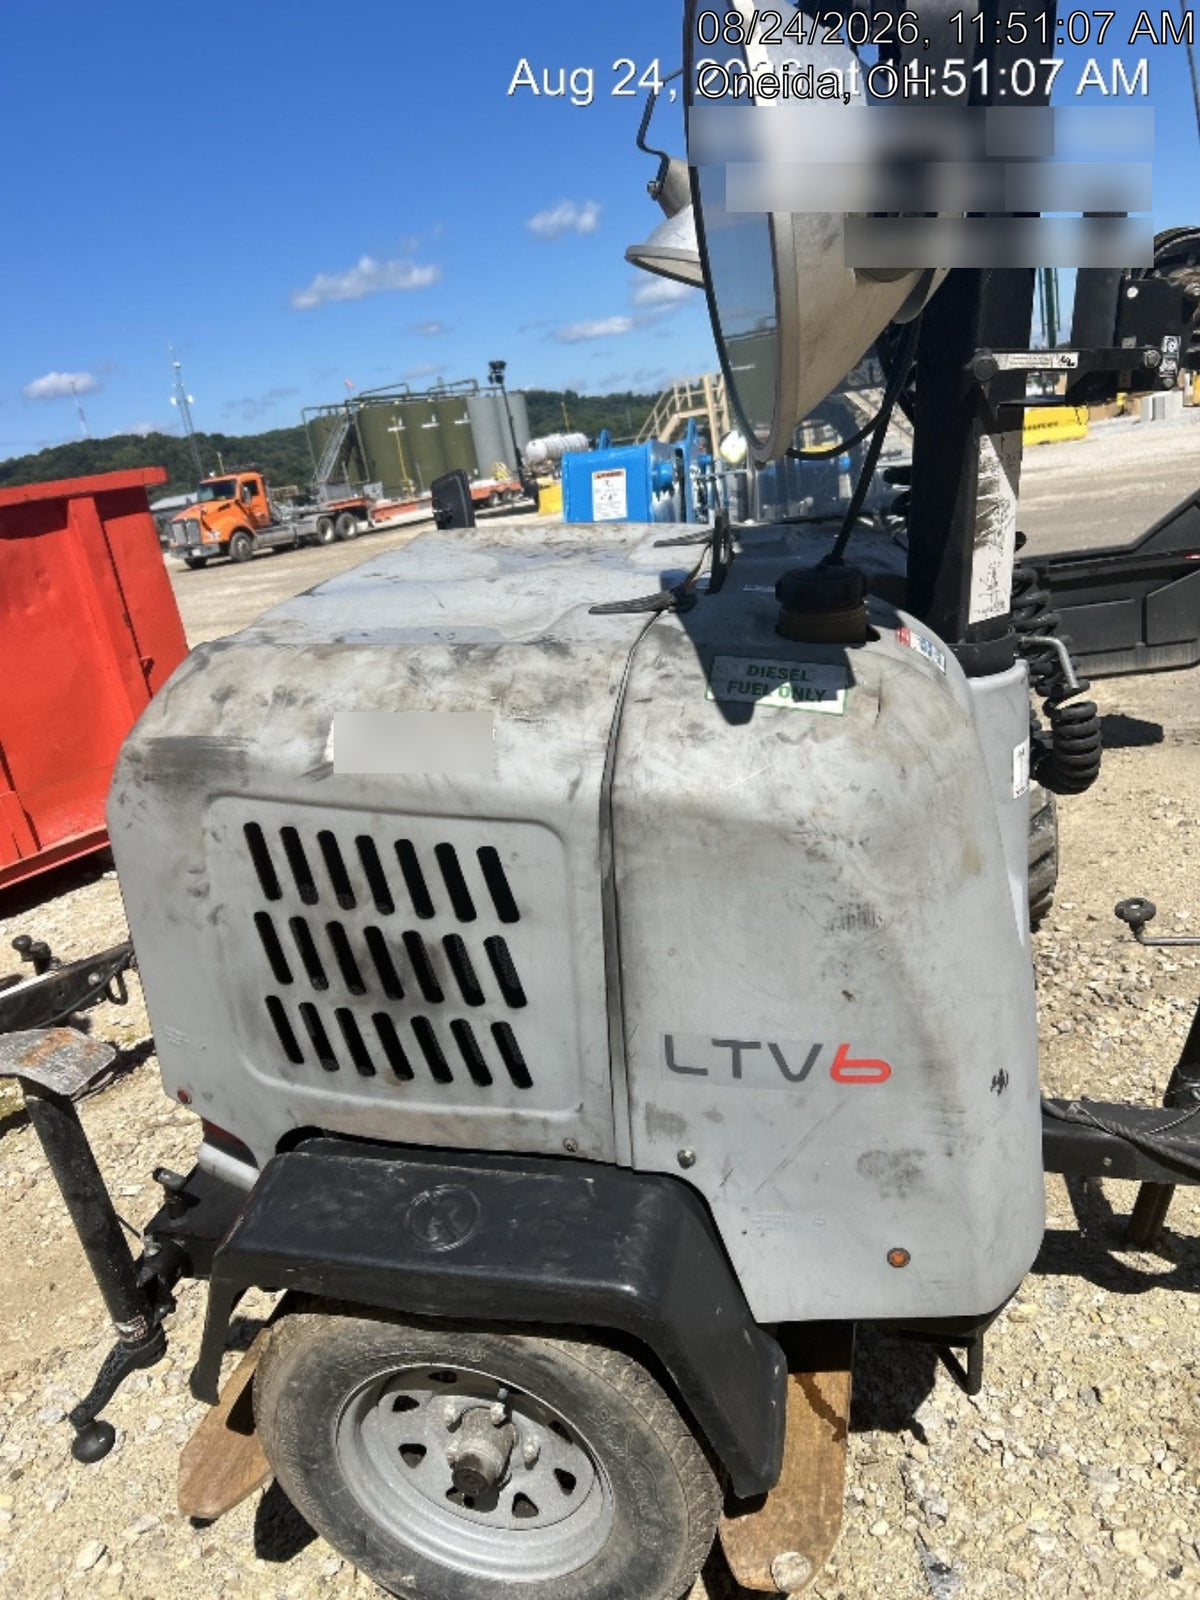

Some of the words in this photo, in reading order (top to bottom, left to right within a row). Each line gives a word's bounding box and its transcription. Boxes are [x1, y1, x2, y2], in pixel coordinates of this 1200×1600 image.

[746, 664, 811, 682] DIESEL
[726, 680, 772, 698] FUEL
[778, 685, 828, 702] ONLY
[664, 1033, 892, 1084] LTV6
